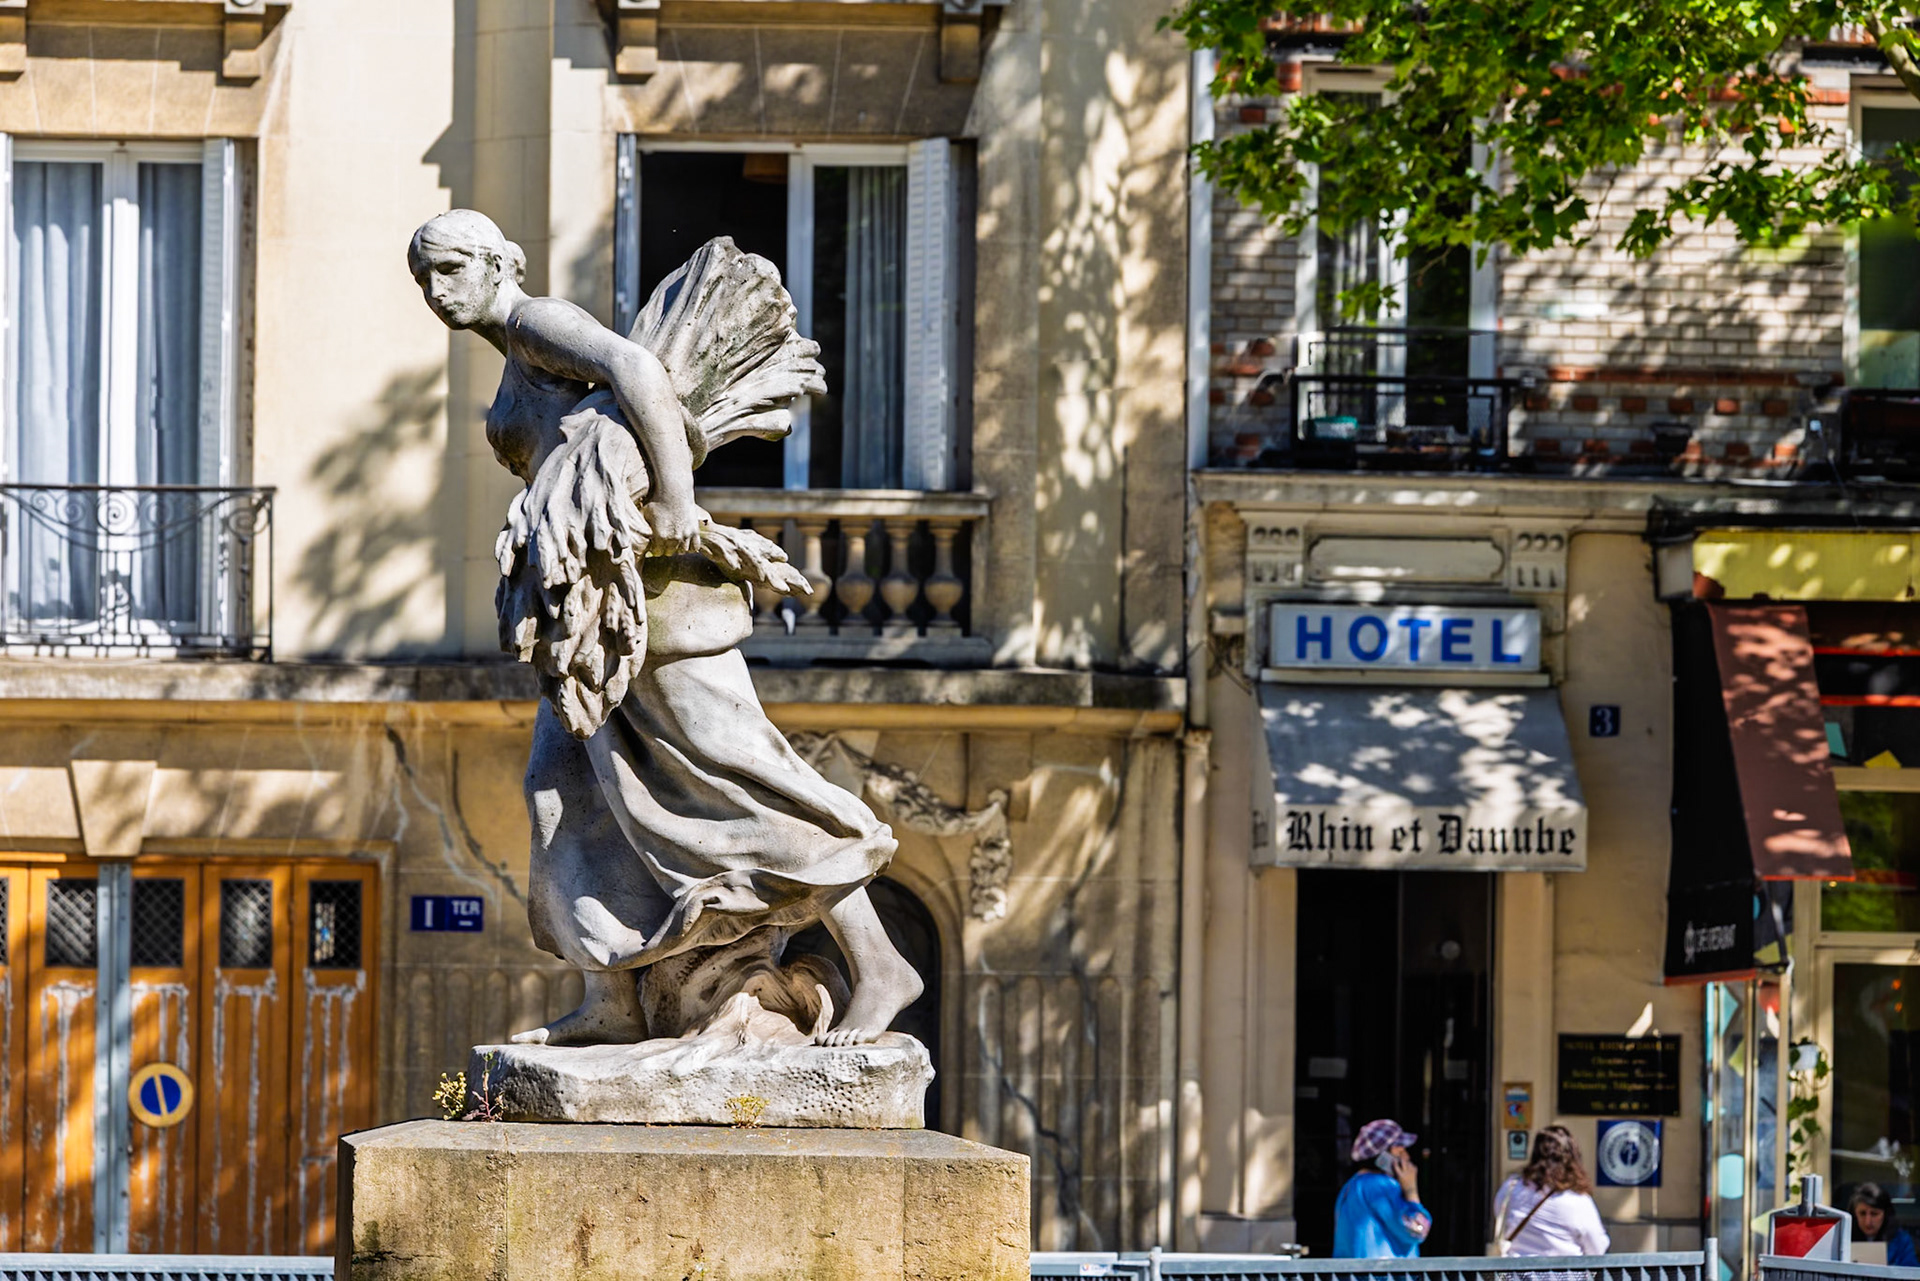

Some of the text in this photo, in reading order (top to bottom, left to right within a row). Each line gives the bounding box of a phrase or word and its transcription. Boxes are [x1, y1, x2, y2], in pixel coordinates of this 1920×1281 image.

[1296, 615, 1522, 663] HOTEL
[1595, 708, 1613, 735] 3
[1287, 810, 1374, 862] Rhin
[1390, 816, 1422, 854] et
[1437, 812, 1577, 856] Danube
[451, 900, 481, 916] TER
